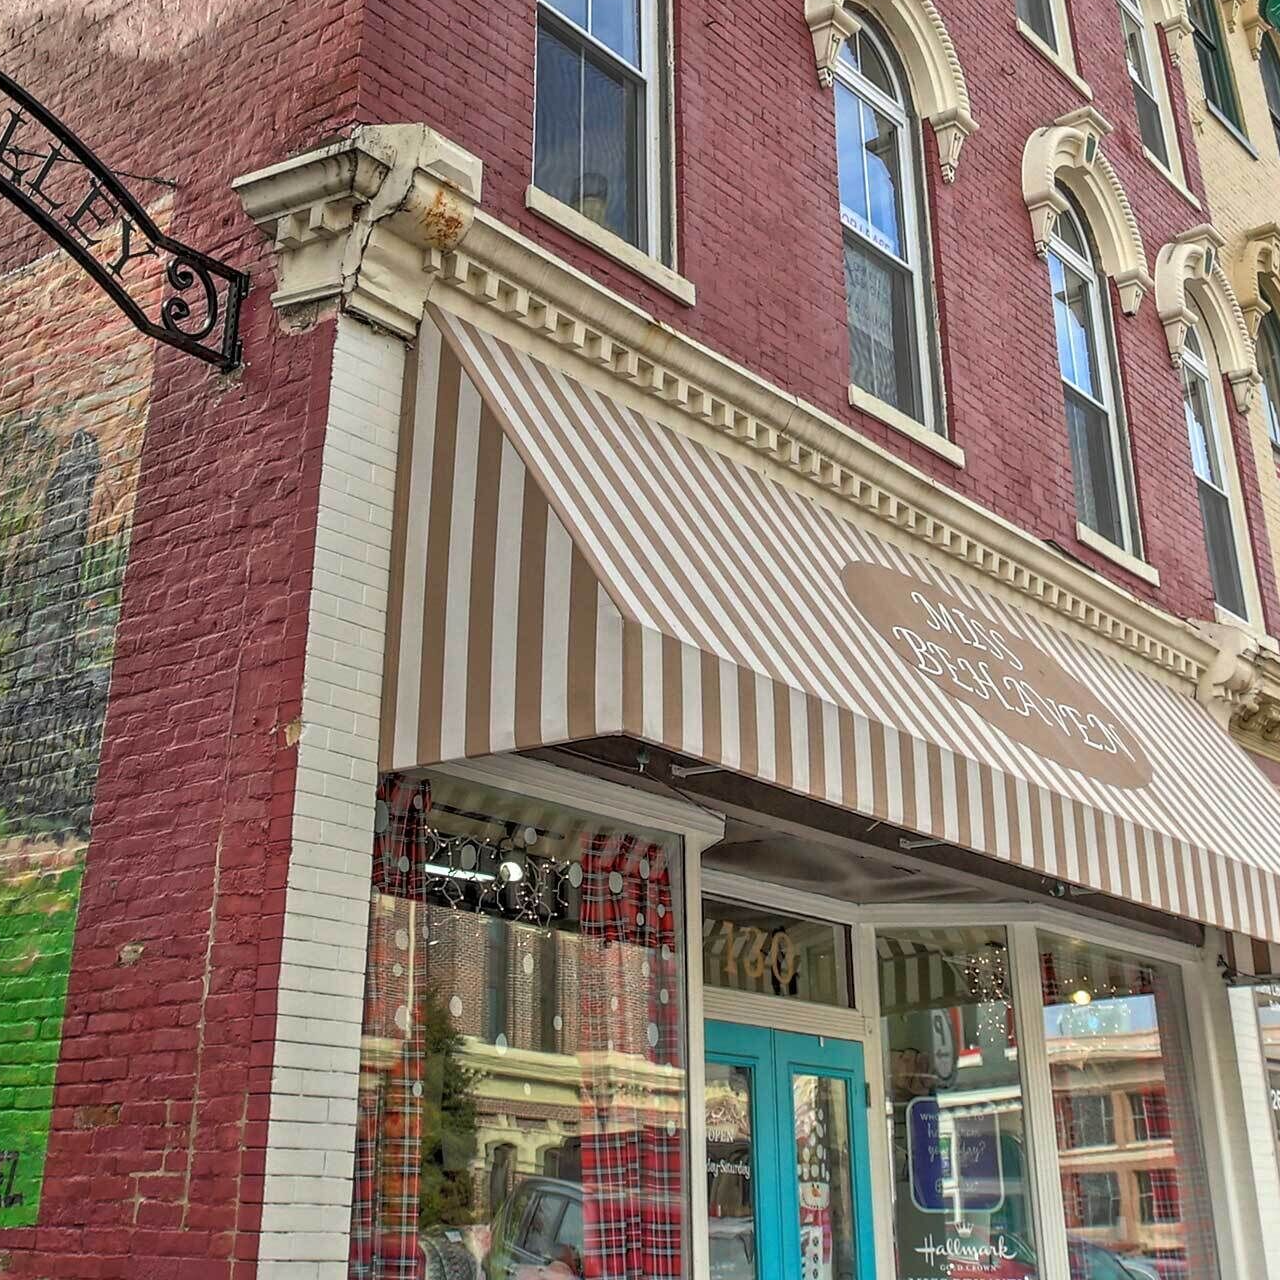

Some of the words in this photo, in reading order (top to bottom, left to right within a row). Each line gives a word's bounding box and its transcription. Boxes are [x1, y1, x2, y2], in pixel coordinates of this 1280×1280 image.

[911, 591, 1024, 671] MISS
[892, 626, 1136, 762] BEHAVEN
[722, 920, 794, 985] 130
[708, 1126, 735, 1143] OPEN
[914, 1233, 1018, 1267] Hallmark
